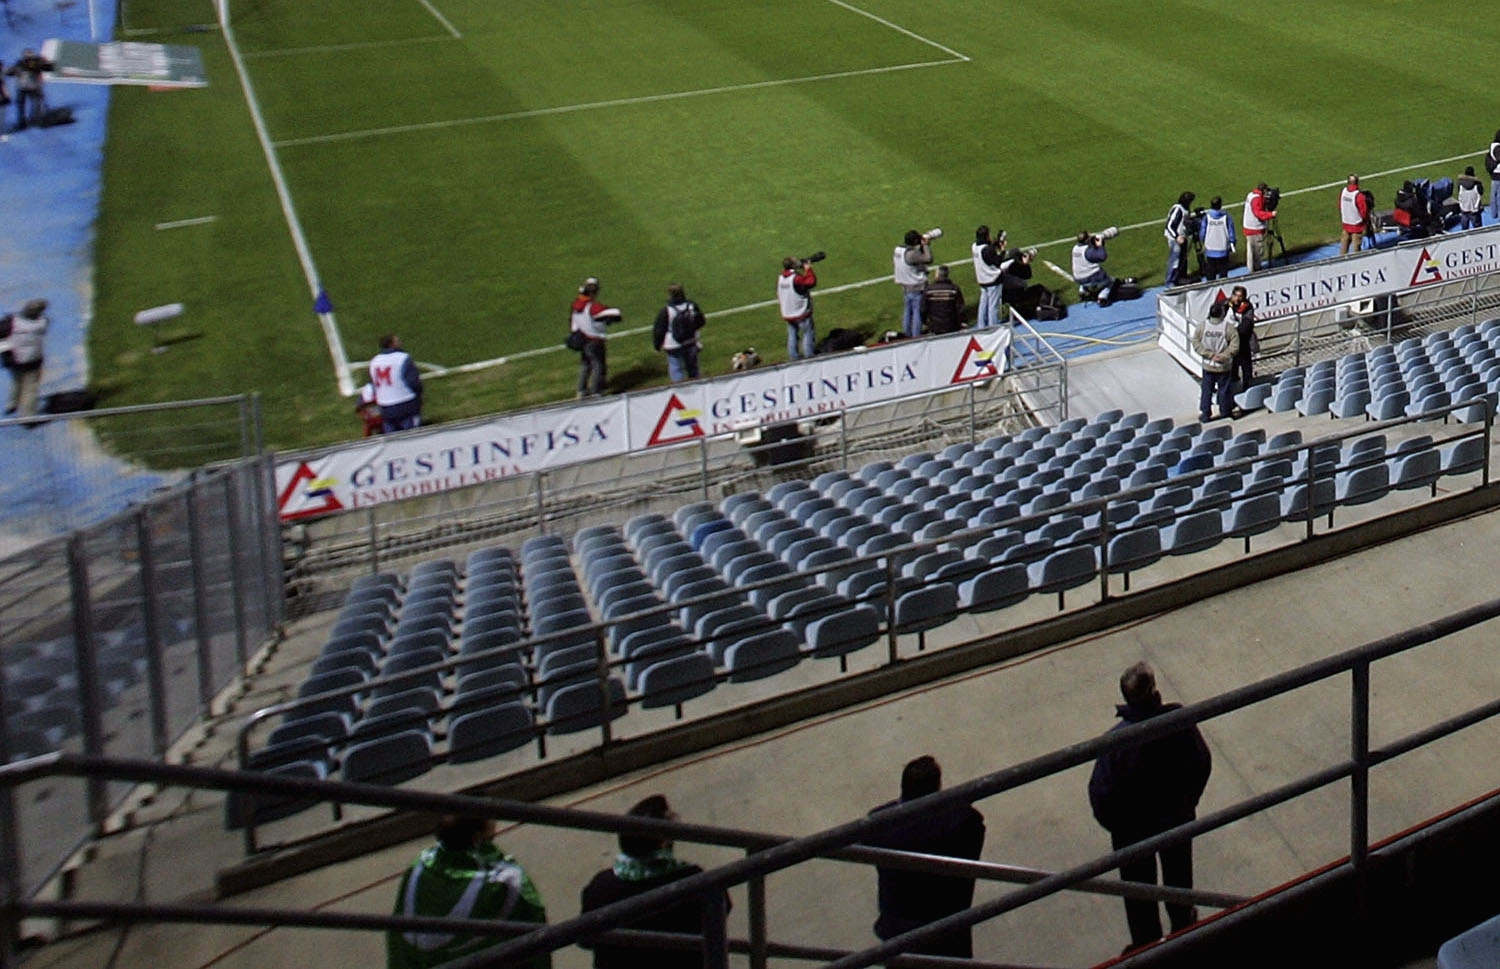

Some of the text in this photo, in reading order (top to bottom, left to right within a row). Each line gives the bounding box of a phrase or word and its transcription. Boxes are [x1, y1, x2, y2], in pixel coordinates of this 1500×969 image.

[1251, 267, 1387, 310] GESTINFISA
[1253, 296, 1337, 320] NMOBILIARIA
[711, 362, 918, 420] GESTINFISA
[713, 400, 847, 433] INBILIARIA
[350, 422, 609, 489] GESTINFISA
[352, 464, 523, 508] INMOBILIARIA
